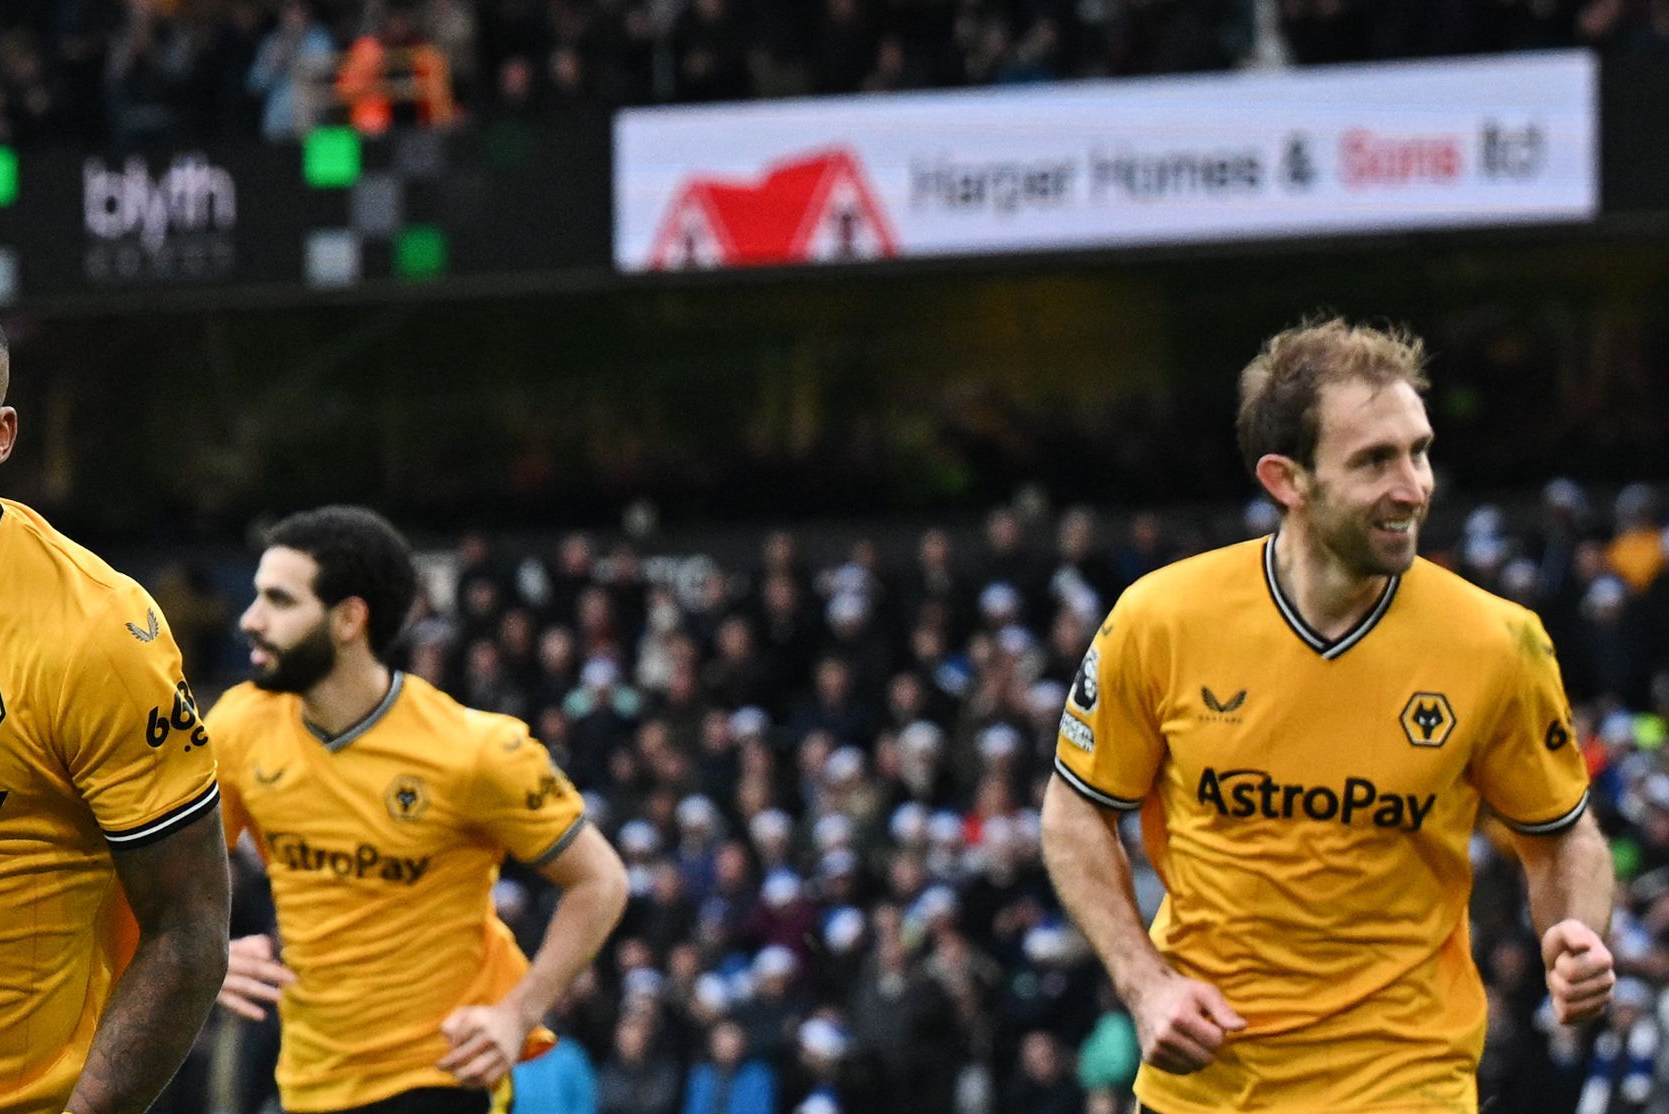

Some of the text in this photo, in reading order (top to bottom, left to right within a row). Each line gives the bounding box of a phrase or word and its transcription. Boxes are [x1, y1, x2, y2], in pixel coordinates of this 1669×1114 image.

[1281, 128, 1316, 190] &
[1338, 124, 1461, 190] Sons
[1197, 767, 1436, 833] AstroPay
